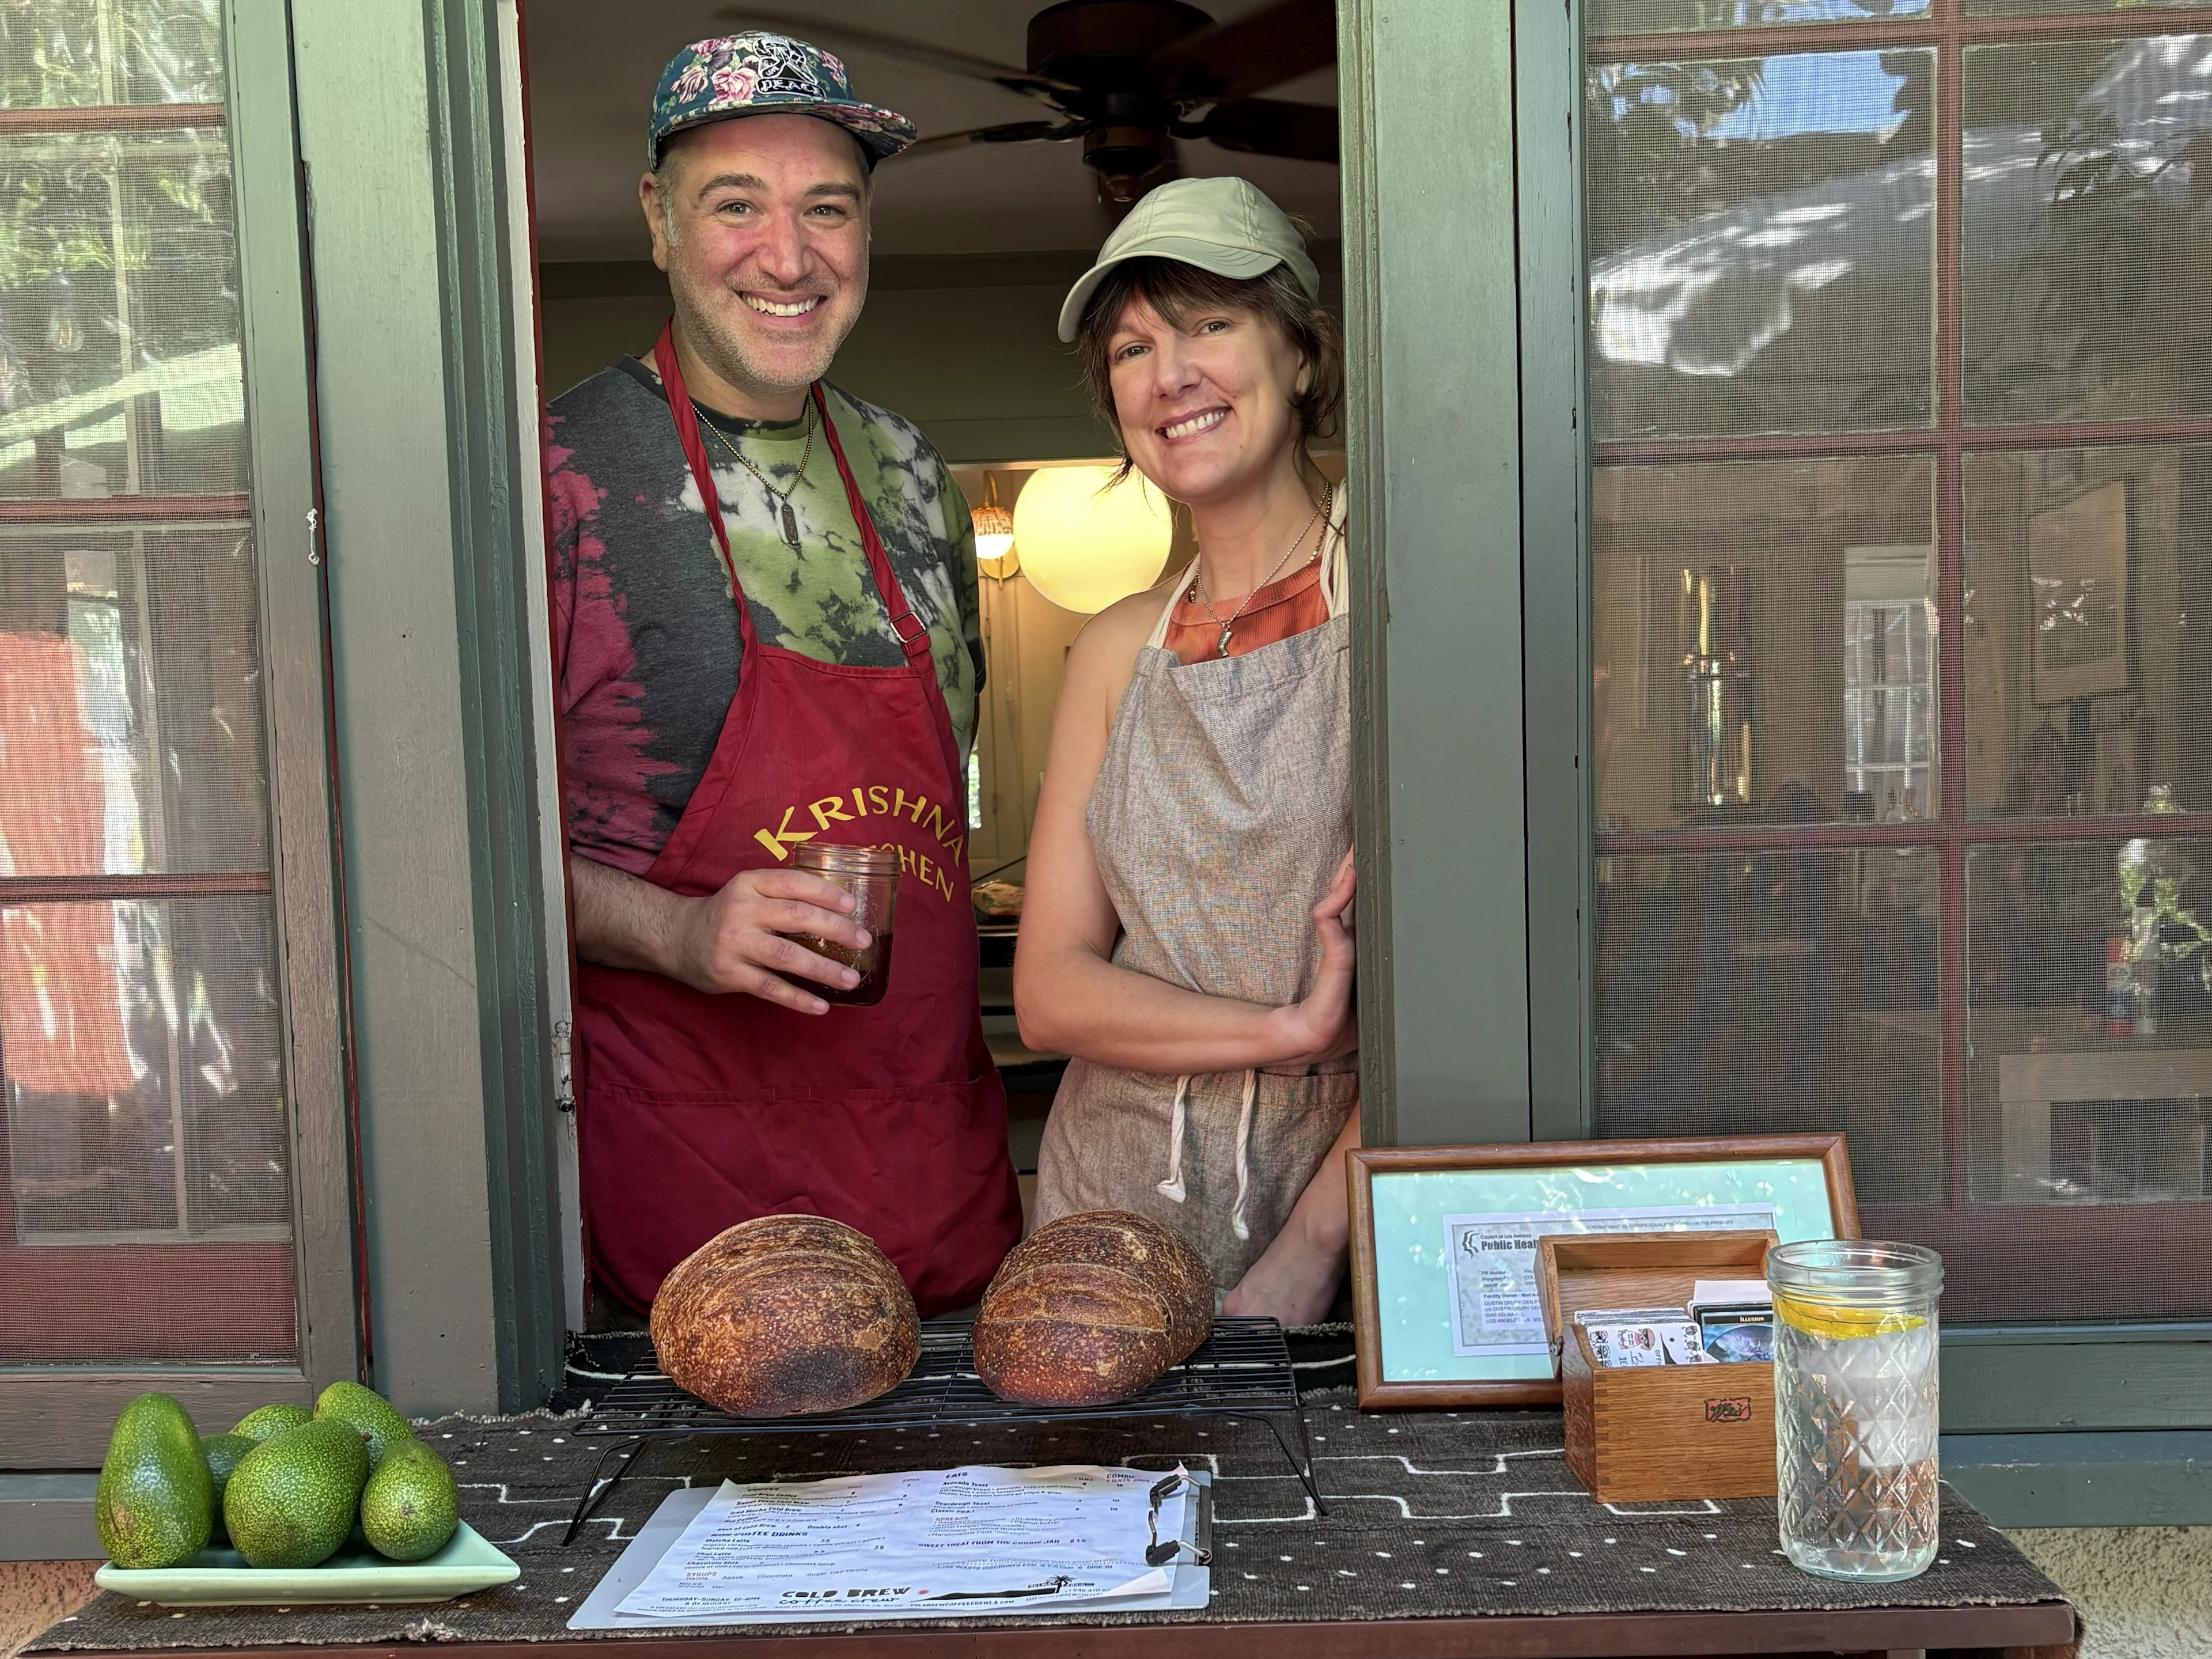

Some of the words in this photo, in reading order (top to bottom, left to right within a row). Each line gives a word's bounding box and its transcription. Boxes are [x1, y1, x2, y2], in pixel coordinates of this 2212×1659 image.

[760, 79, 823, 97] PEACE
[753, 785, 964, 868] KRISHNA
[1482, 1241, 1512, 1251] Public
[1514, 1240, 1539, 1249] Heal
[847, 1587, 911, 1597] BREW
